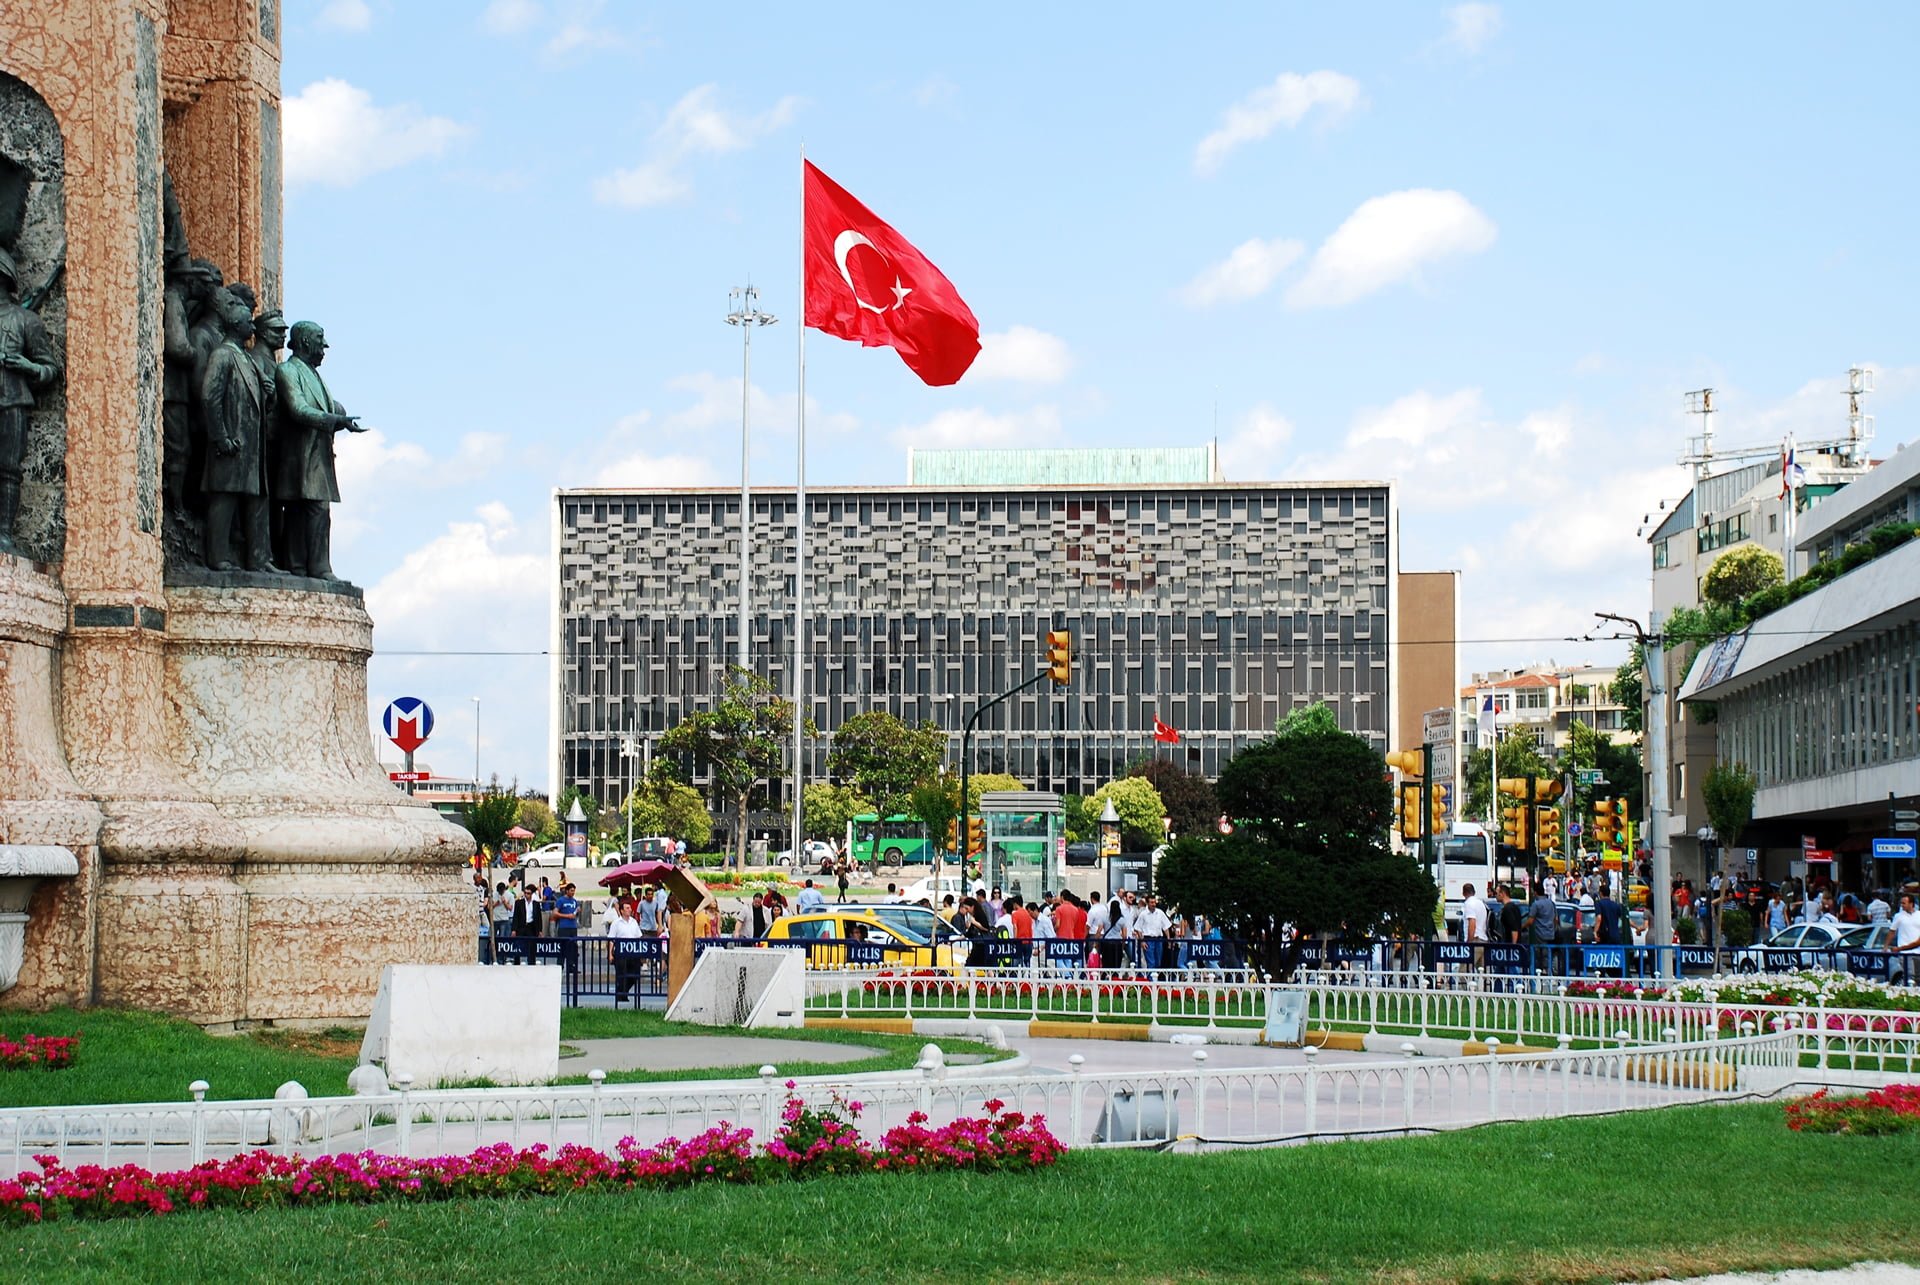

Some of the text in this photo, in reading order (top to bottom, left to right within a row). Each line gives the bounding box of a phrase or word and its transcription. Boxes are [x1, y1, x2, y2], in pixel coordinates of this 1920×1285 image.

[391, 702, 424, 739] M
[620, 941, 648, 954] POLİS
[1051, 943, 1080, 955] POLİS
[1192, 944, 1221, 957] POLİS
[1589, 951, 1621, 968] POLİS
